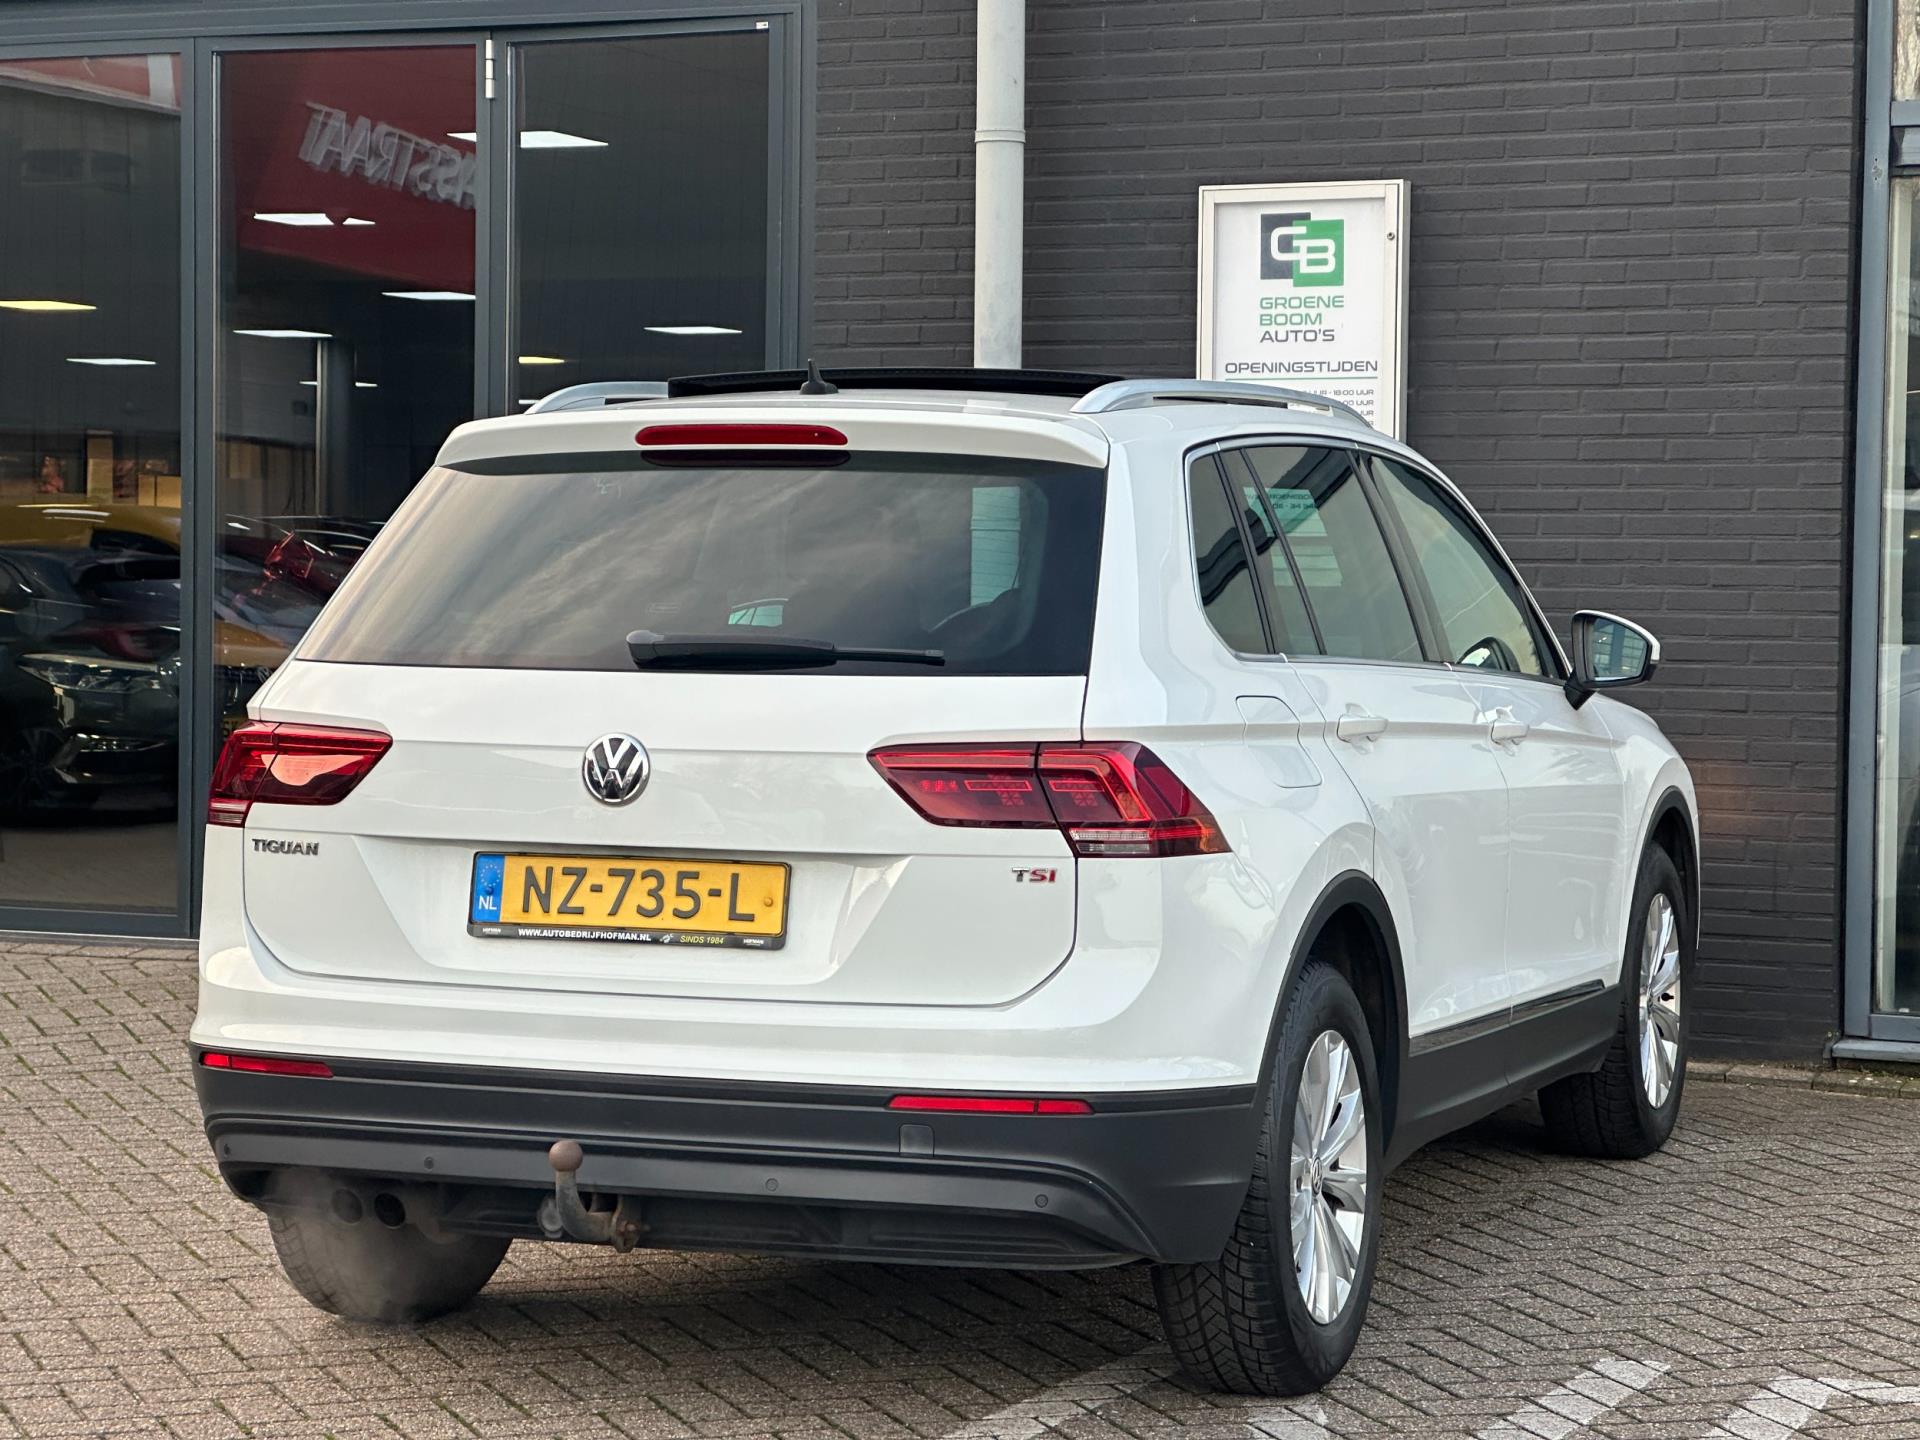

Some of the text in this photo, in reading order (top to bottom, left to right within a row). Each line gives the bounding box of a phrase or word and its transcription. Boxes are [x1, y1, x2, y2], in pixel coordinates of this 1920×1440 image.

[1260, 295, 1345, 309] GROENE
[1260, 313, 1323, 326] BOOM
[1260, 329, 1335, 343] AUTO'S
[1225, 360, 1378, 374] OPENINGSTIJDEN
[252, 838, 320, 856] TIGUAN
[1011, 867, 1057, 883] TSI
[521, 865, 756, 923] NZ-735-L
[478, 896, 497, 911] NL
[517, 928, 652, 941] WWW.AUTOBEDRIJFHOFMAN.NL
[680, 935, 724, 945] SINDS 1984
